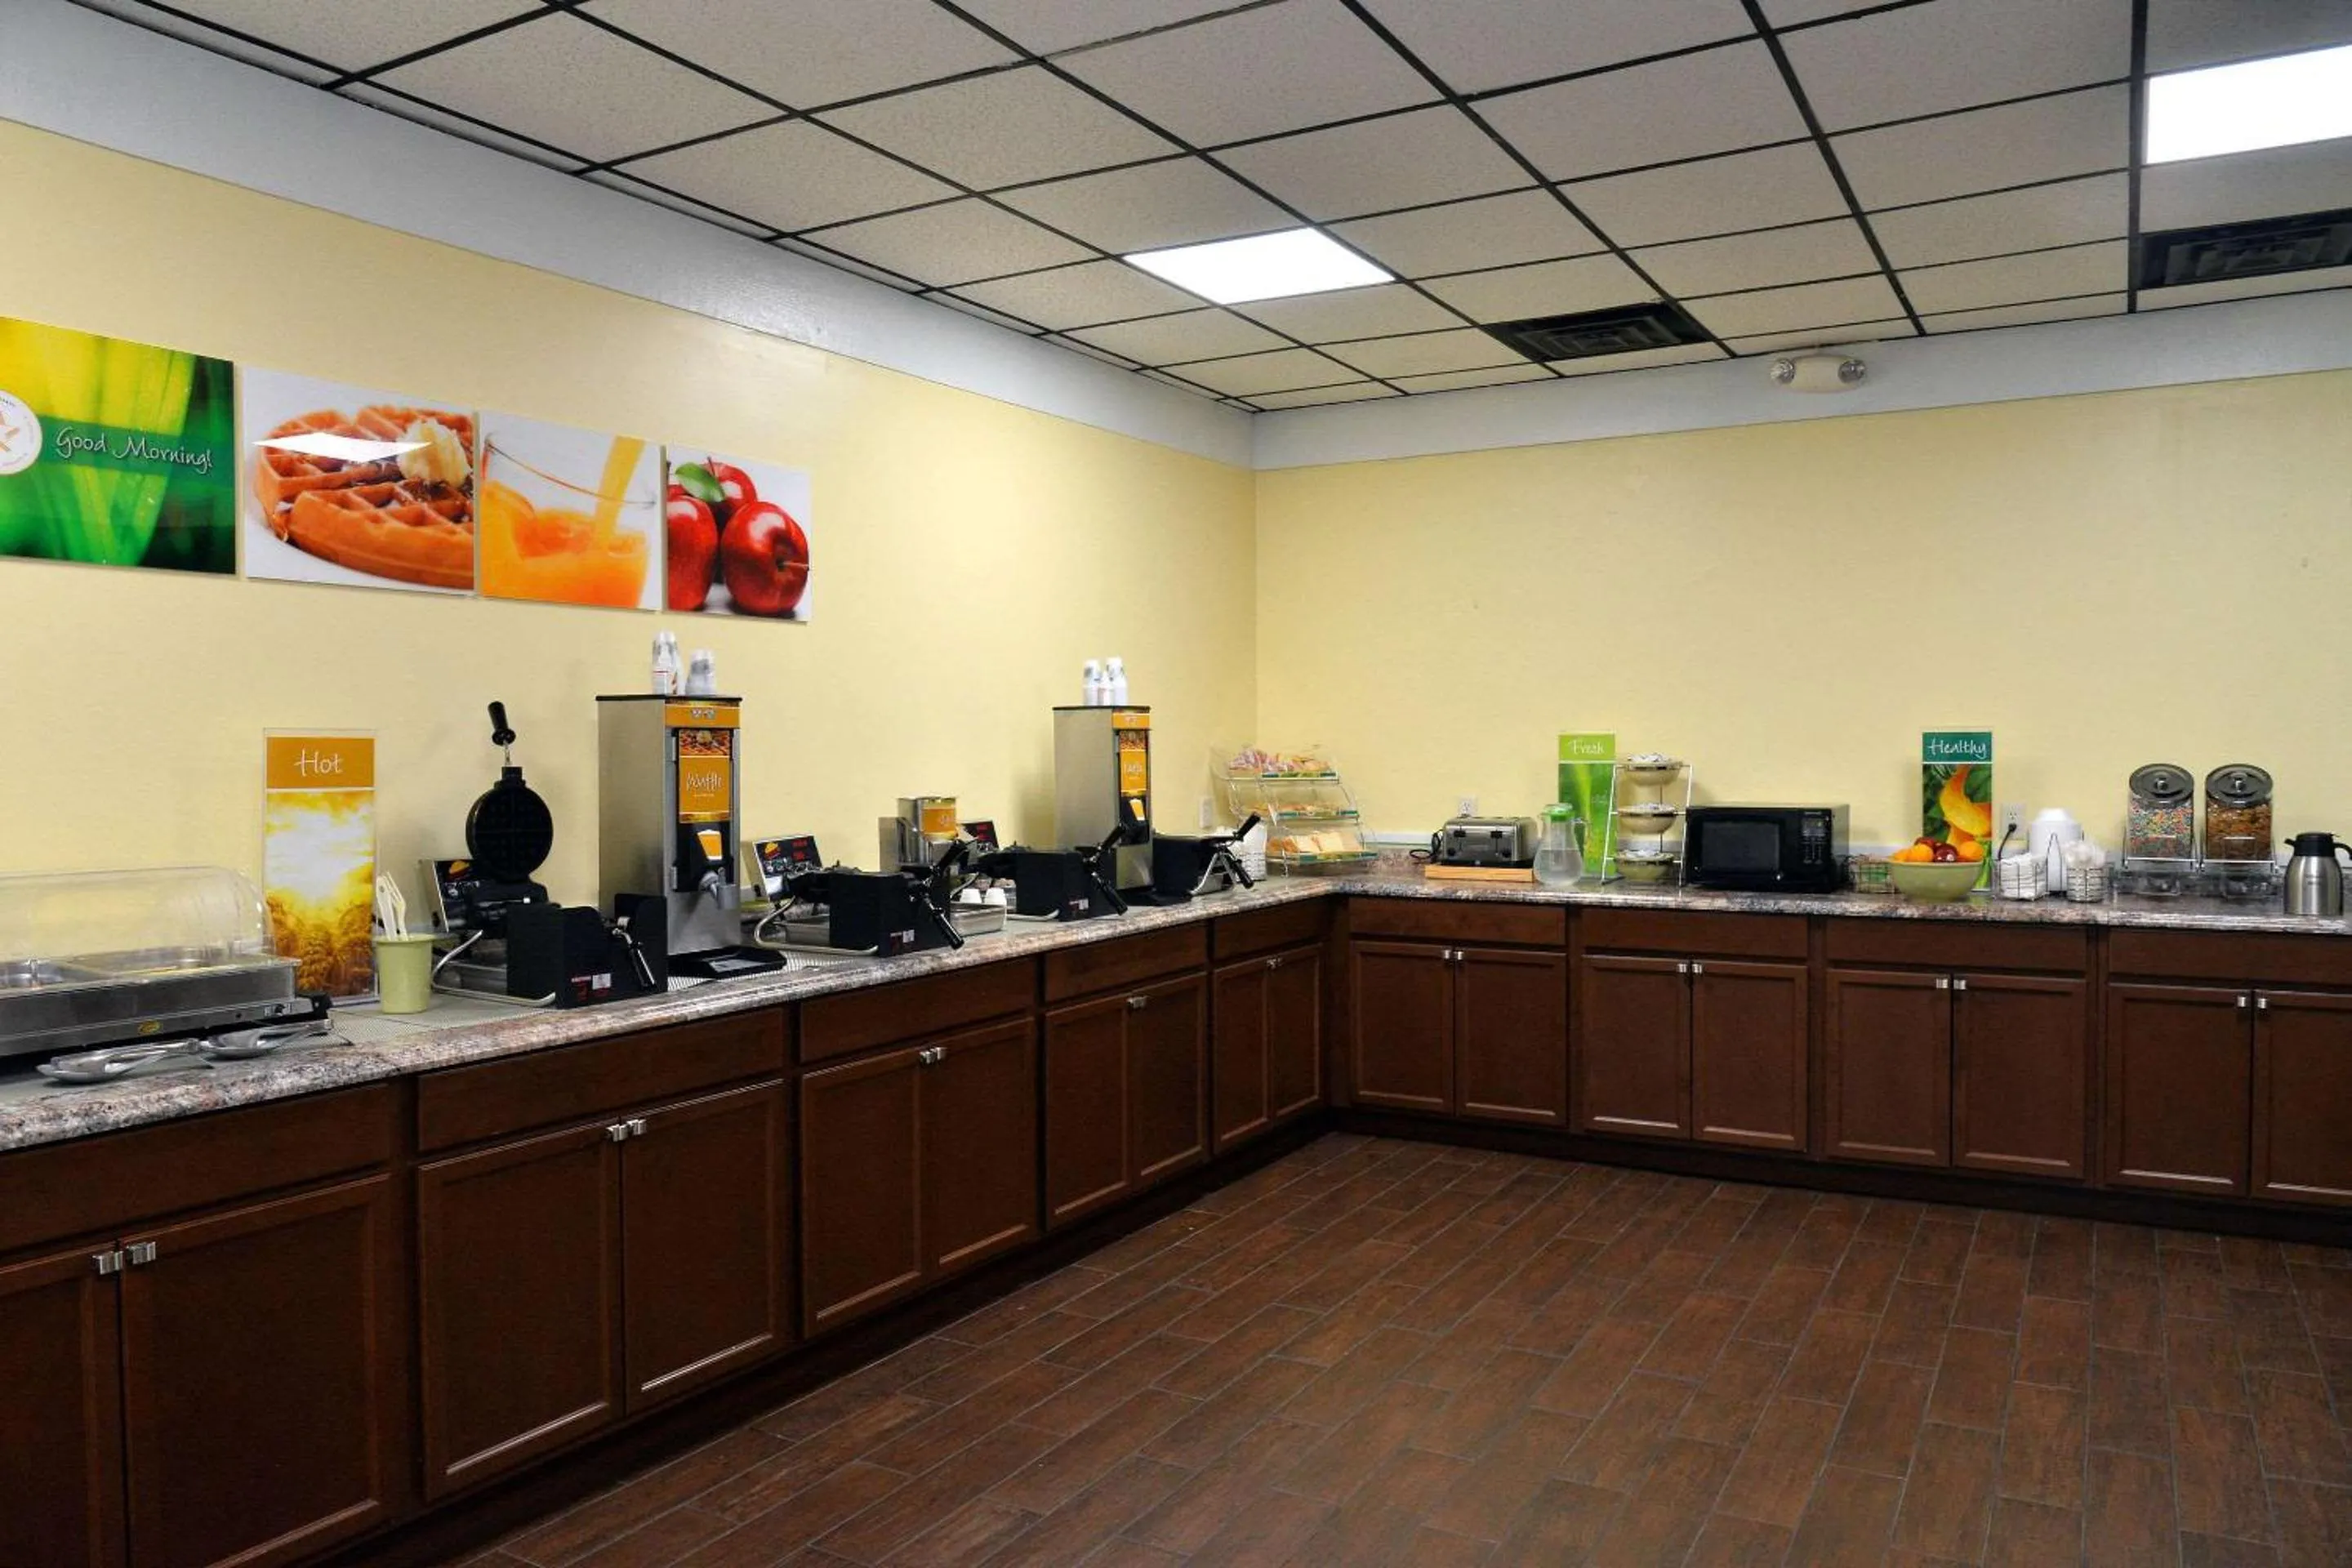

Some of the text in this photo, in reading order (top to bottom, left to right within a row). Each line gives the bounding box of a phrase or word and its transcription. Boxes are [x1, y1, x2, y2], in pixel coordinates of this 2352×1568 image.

[56, 425, 213, 474] Good Morning!
[294, 748, 343, 777] Hot
[1927, 737, 1987, 760] Healthy
